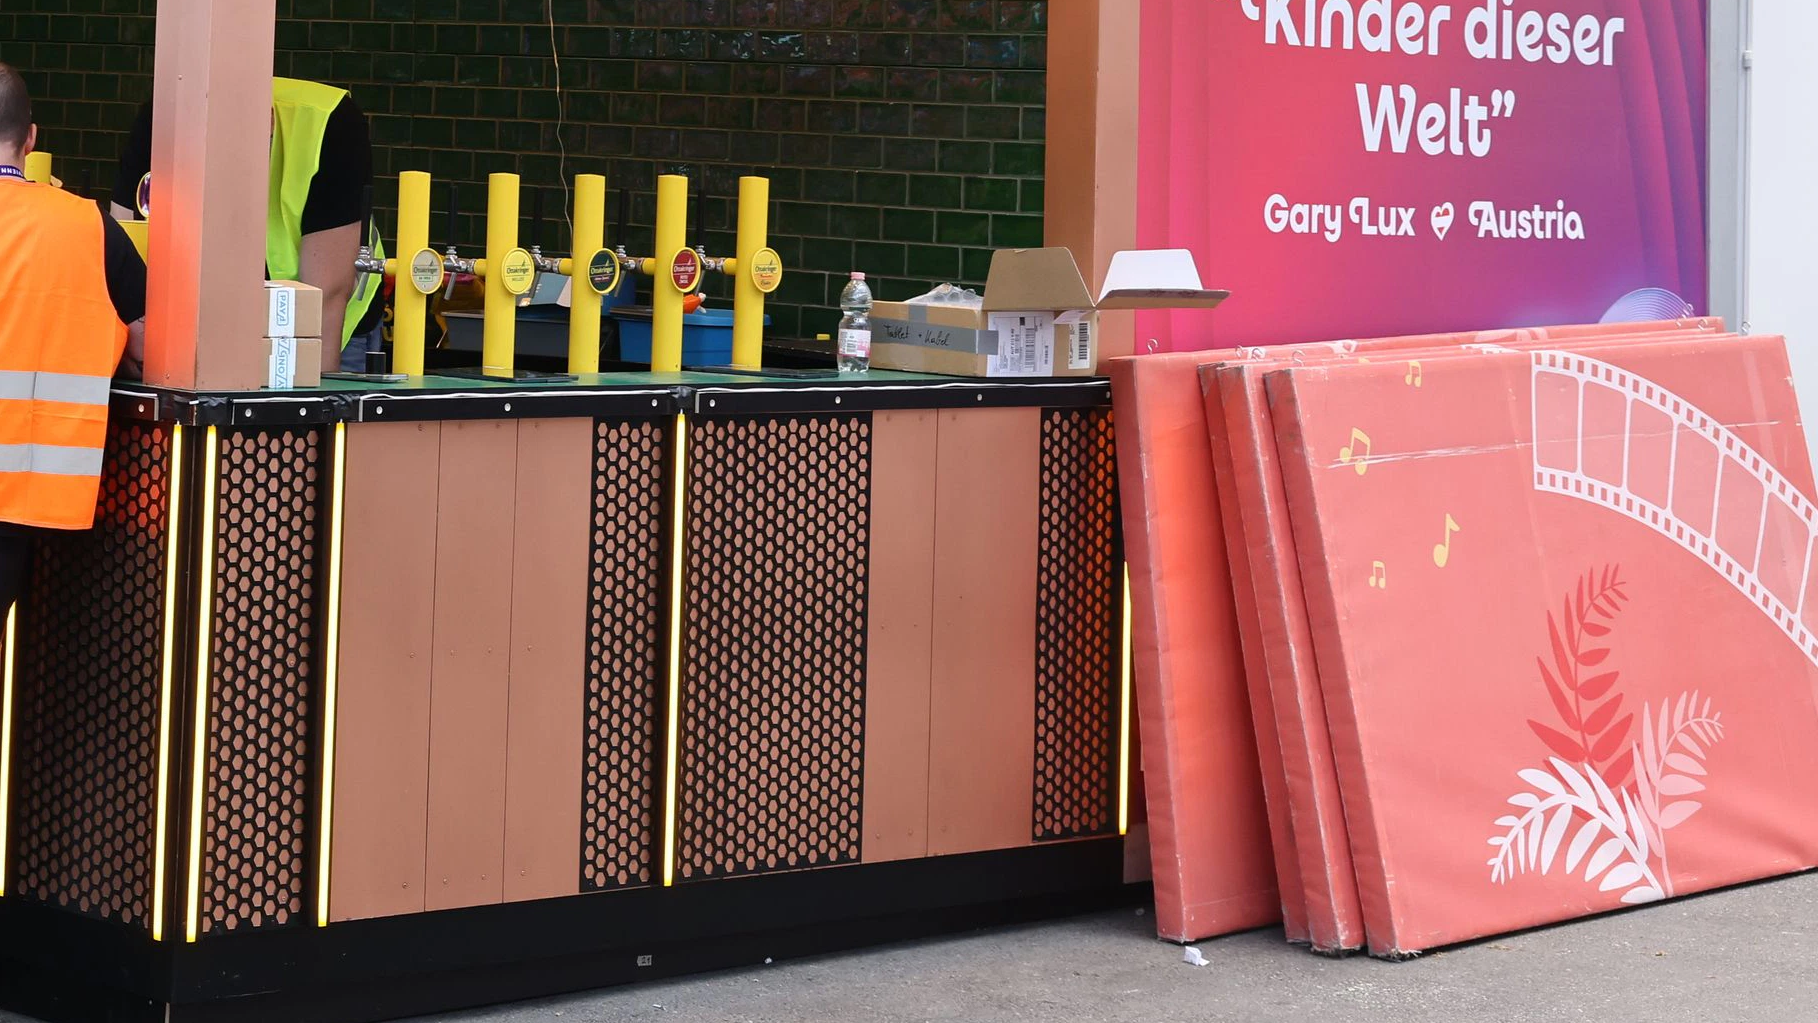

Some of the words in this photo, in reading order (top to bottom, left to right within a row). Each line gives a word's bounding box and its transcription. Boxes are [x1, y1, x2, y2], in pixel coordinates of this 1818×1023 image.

[1264, 194, 1342, 243] Gary
[1348, 197, 1416, 237] Lux
[1468, 199, 1585, 240] Austria
